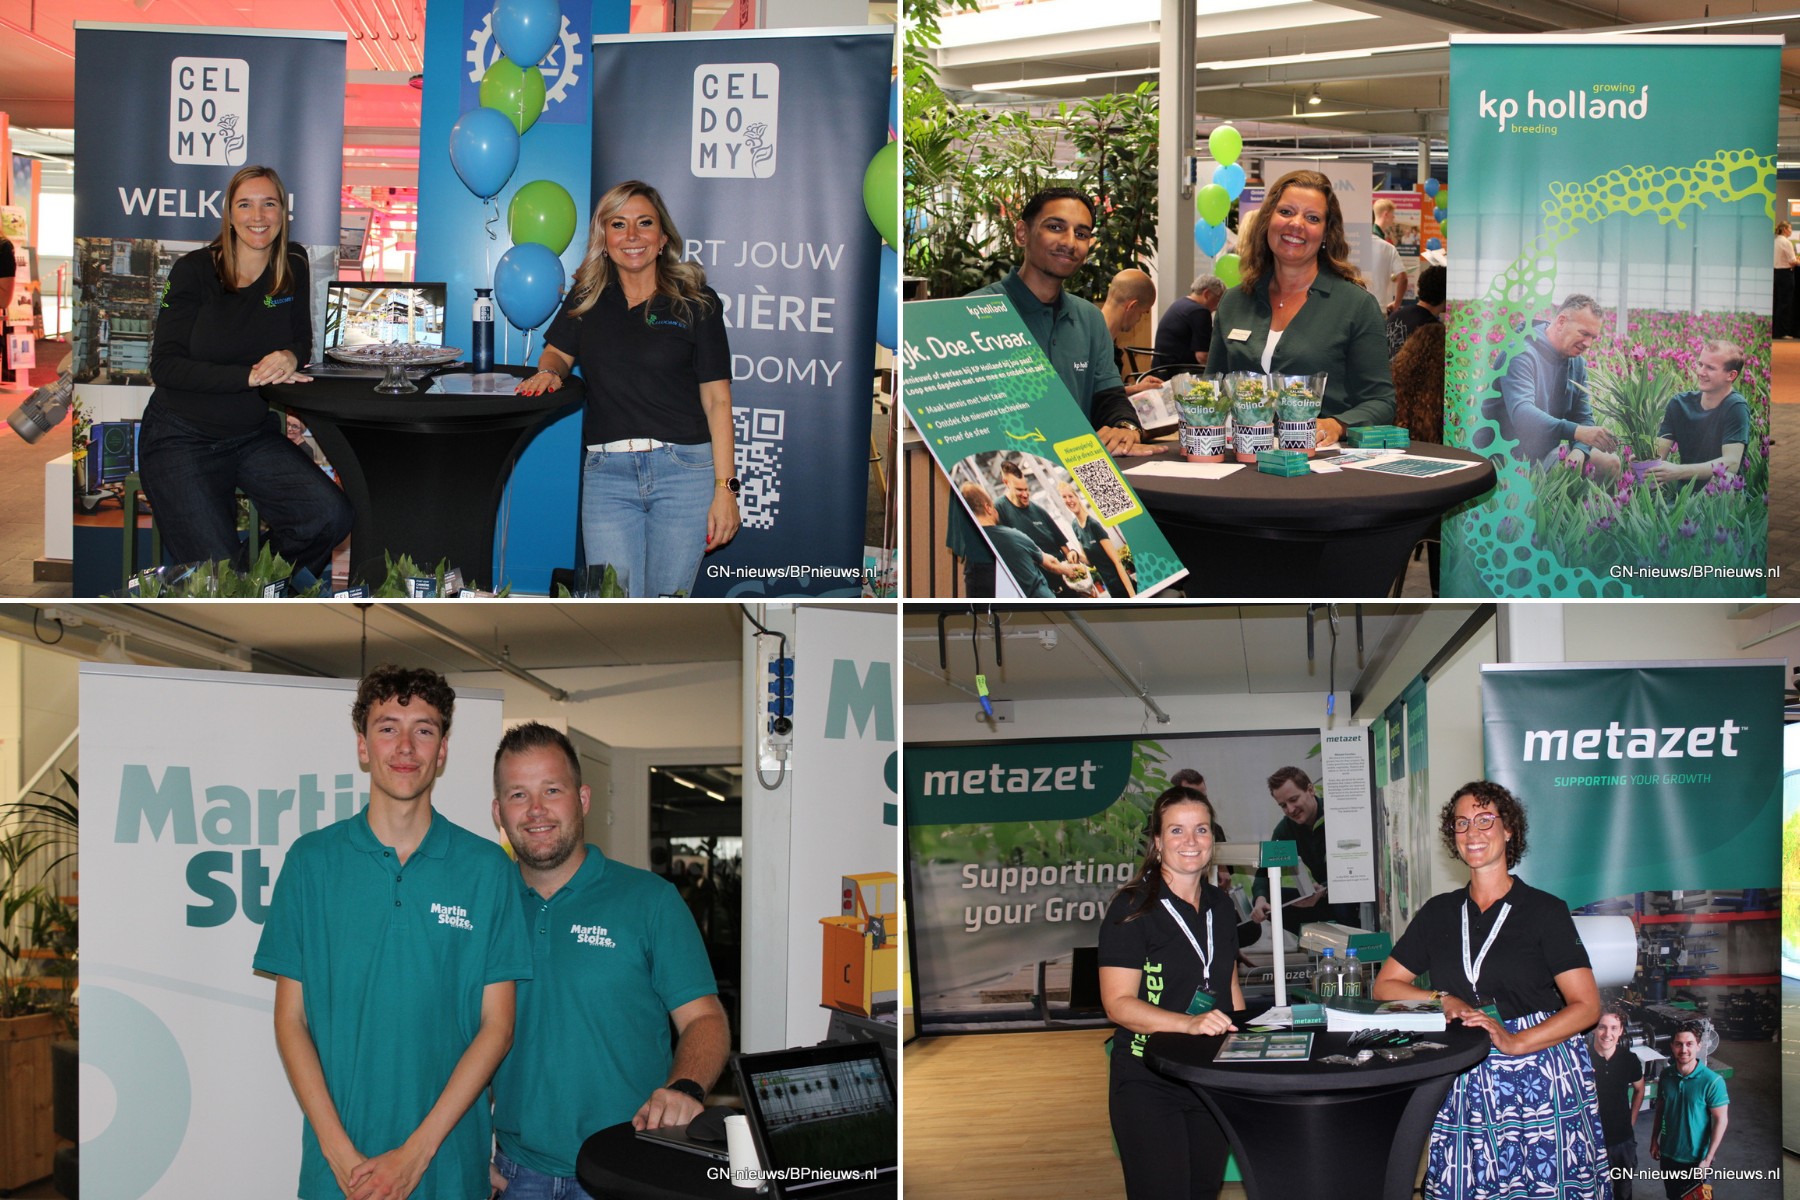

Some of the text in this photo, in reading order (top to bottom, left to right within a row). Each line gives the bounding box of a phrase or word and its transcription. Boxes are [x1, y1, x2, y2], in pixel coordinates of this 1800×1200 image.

[178, 66, 240, 93] CEL
[702, 72, 769, 100] CEL
[1592, 83, 1636, 94] growing
[178, 98, 217, 124] DO
[1479, 84, 1649, 132] kp holland
[700, 106, 743, 134] DO
[1511, 123, 1558, 136] breeding
[177, 131, 217, 158] MY
[698, 142, 742, 170] MY
[734, 241, 844, 270] JOUW
[977, 301, 1008, 314] holland
[926, 337, 975, 359] Doe.
[970, 331, 1032, 352] Ervaar.
[941, 369, 963, 378] werken
[980, 362, 1003, 372] Holland
[905, 388, 924, 396] Loop
[937, 379, 962, 391] dagdeel
[962, 378, 975, 386] met
[925, 404, 946, 414] Maak
[944, 399, 967, 410] kennis
[966, 396, 980, 405] met
[979, 394, 992, 402] het
[1281, 399, 1321, 407] Rosalina
[935, 416, 962, 428] Ontdek
[961, 414, 971, 423] de
[970, 407, 999, 420] nieuwste
[944, 427, 990, 444] Proef de sfeer
[1326, 735, 1362, 743] metazet
[1554, 774, 1711, 787] SUPPORTING YOUR GROWTH
[114, 764, 370, 846] Marti
[962, 858, 1134, 894] Supporting
[430, 903, 467, 917] Martin
[964, 902, 1038, 933] your
[570, 924, 607, 936] Martin
